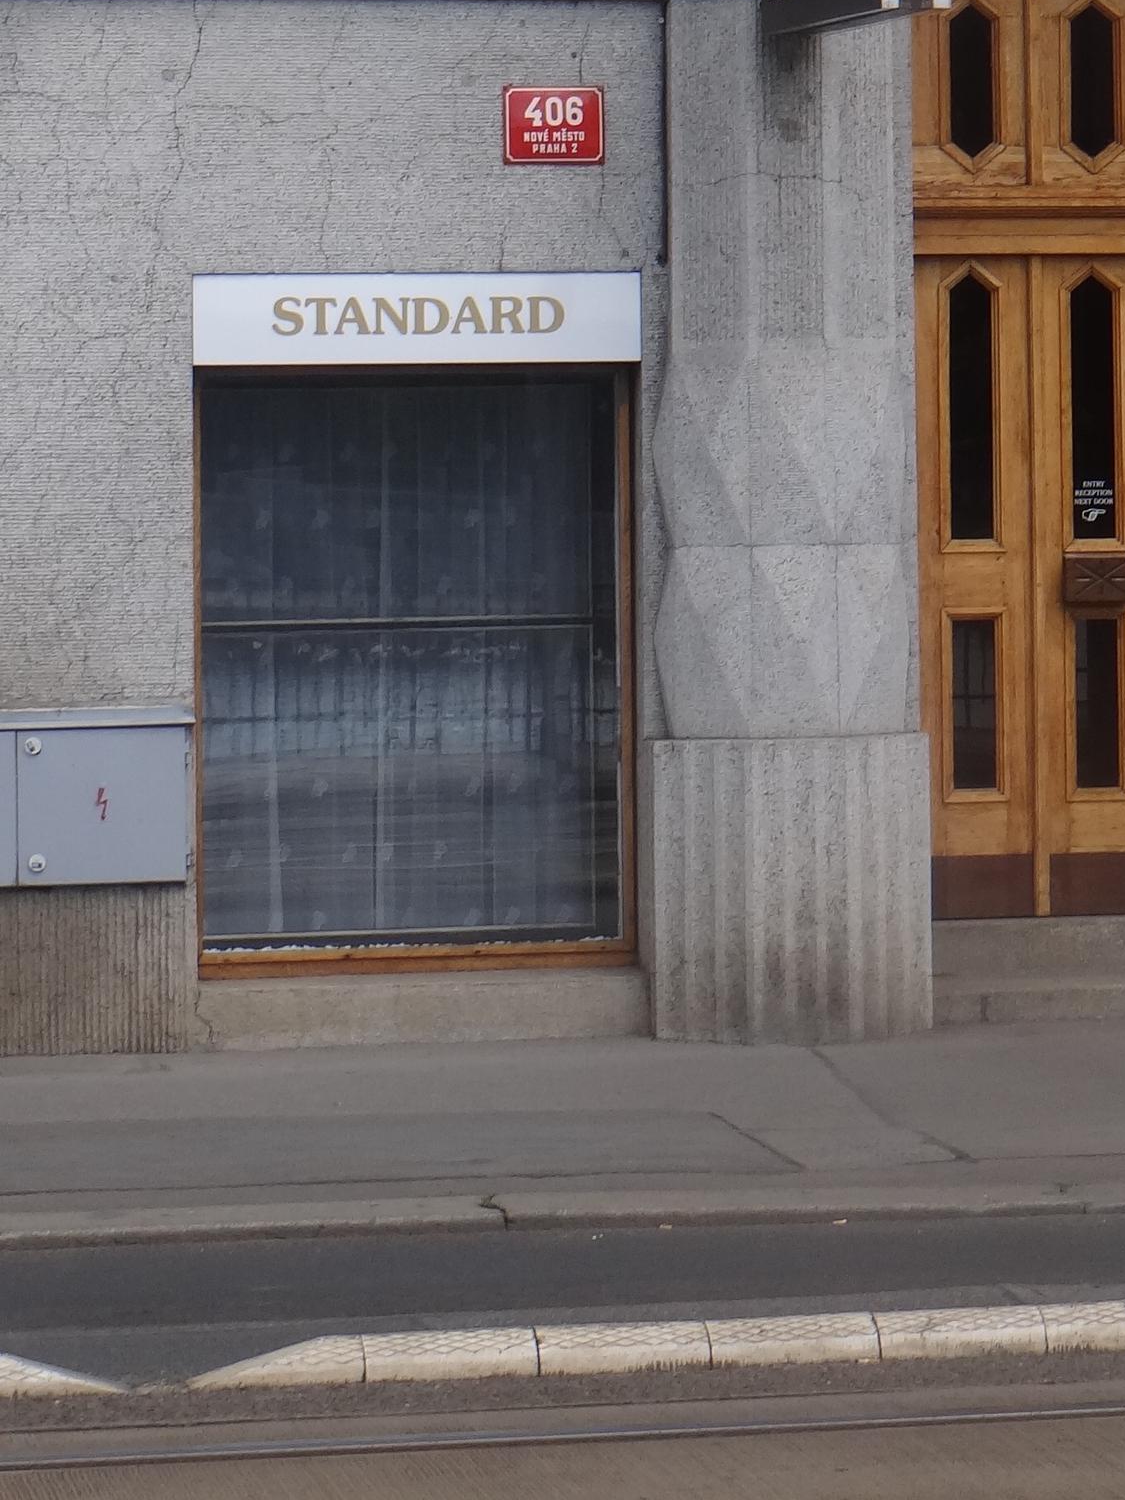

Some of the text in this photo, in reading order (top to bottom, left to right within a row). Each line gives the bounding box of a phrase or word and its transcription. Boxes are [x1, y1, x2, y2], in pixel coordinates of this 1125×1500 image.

[524, 96, 583, 127] 406
[523, 127, 585, 142] NOVÉ MĚSTO
[532, 143, 578, 154] PRAHA 2
[272, 296, 565, 336] STANDARD
[1075, 489, 1113, 497] RECEPTION
